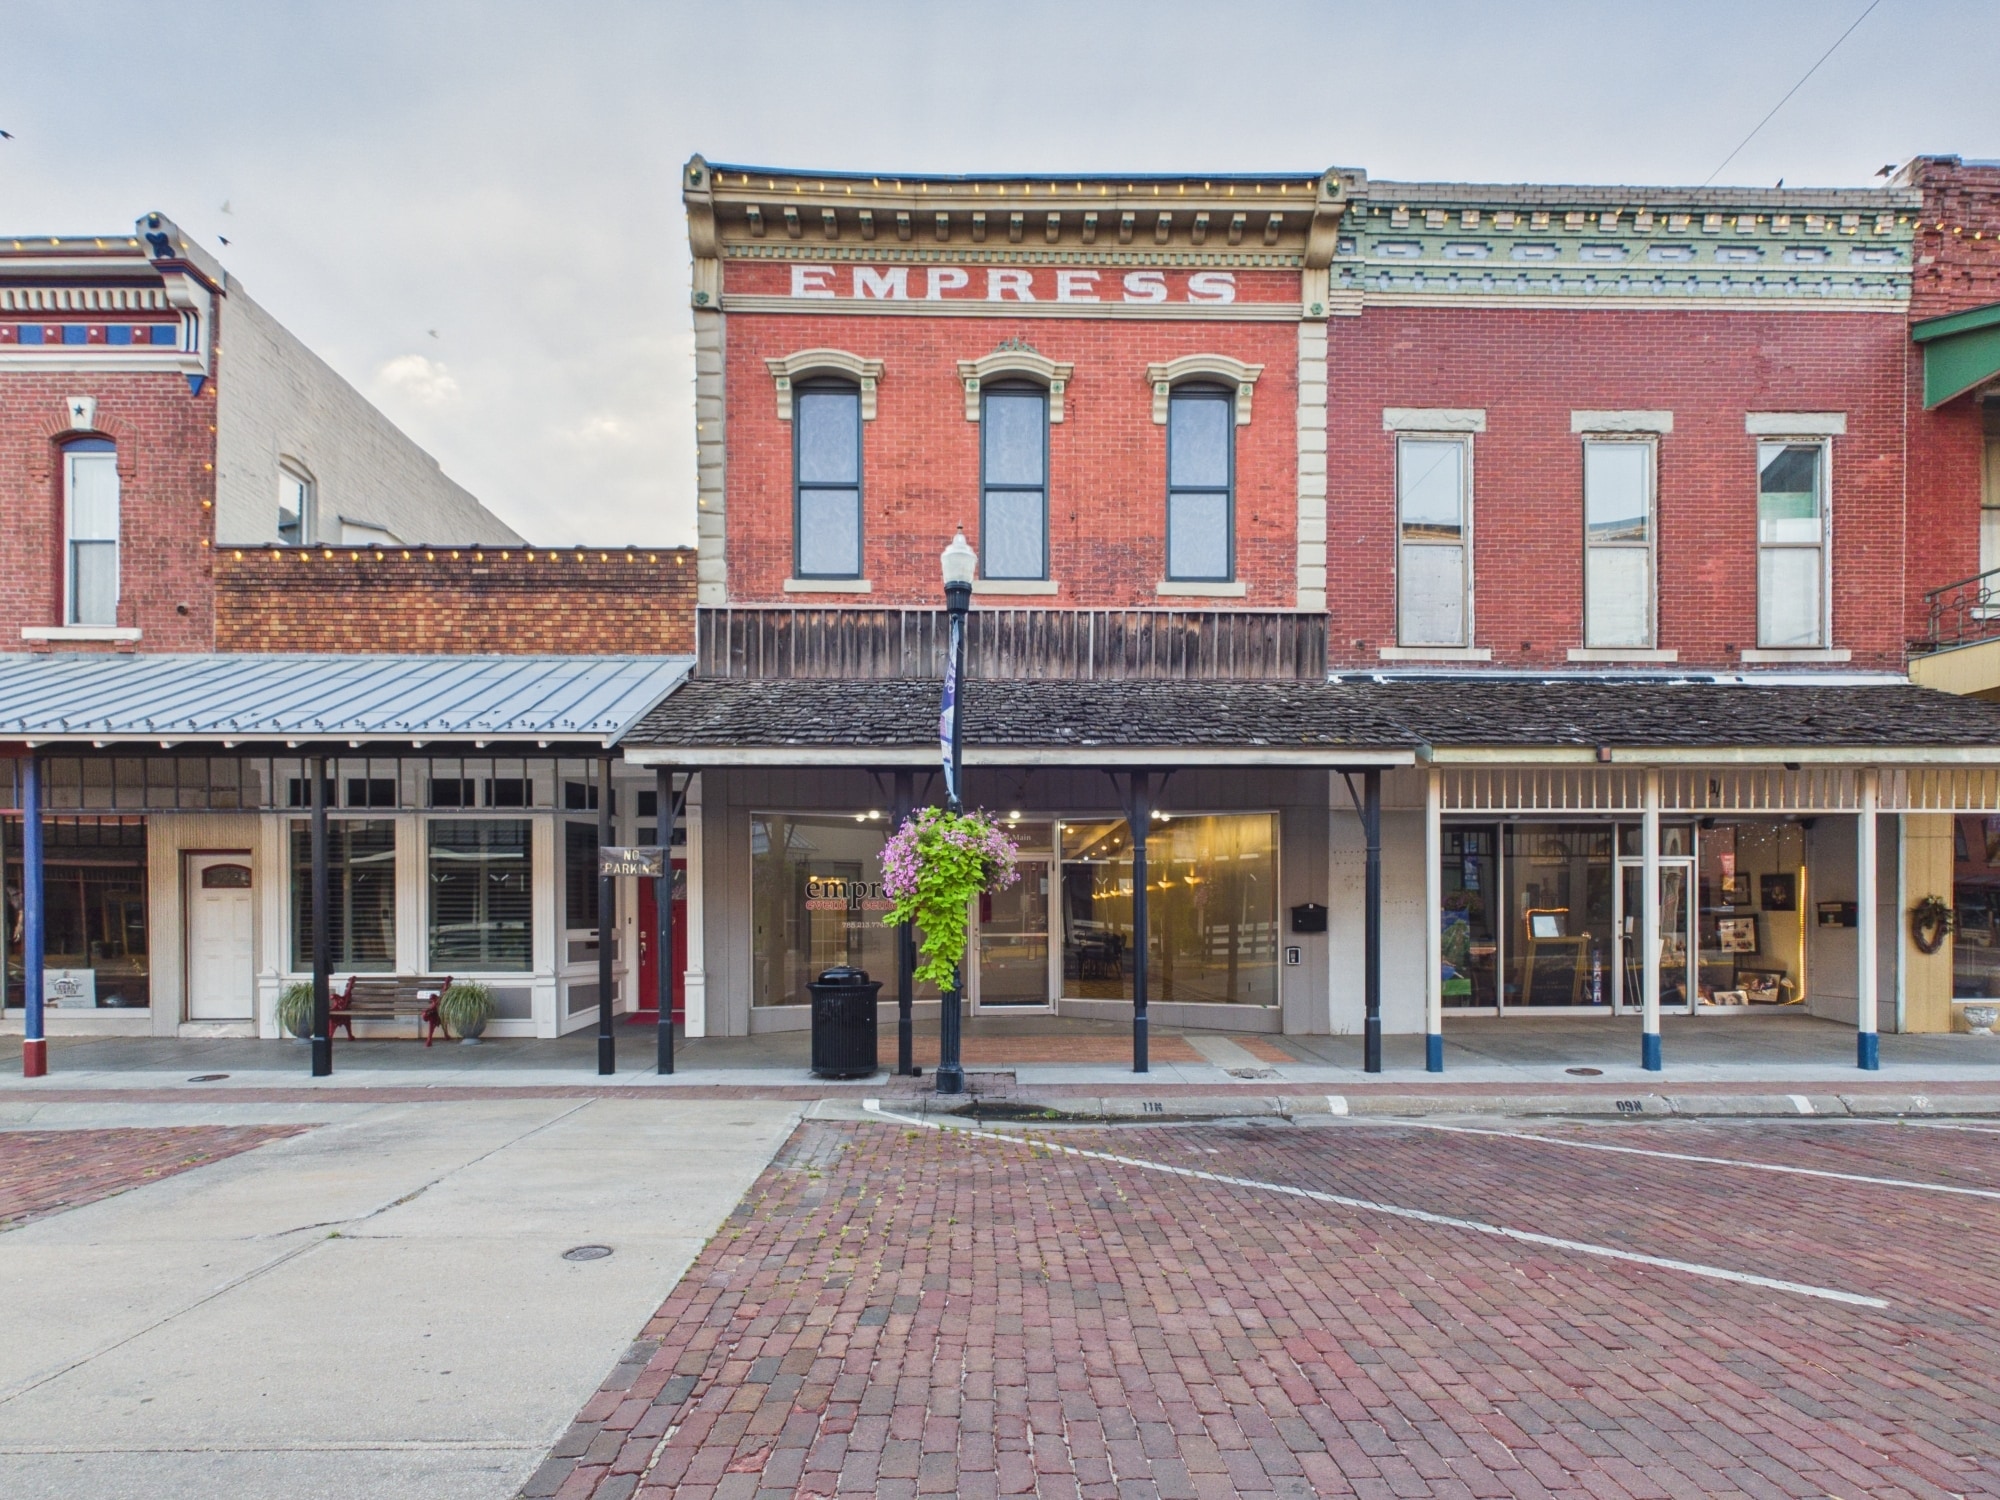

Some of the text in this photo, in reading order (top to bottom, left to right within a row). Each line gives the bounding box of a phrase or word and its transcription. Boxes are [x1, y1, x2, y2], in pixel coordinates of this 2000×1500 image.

[790, 264, 1238, 305] EMPRESS
[623, 849, 640, 861] NO
[805, 899, 847, 911] event
